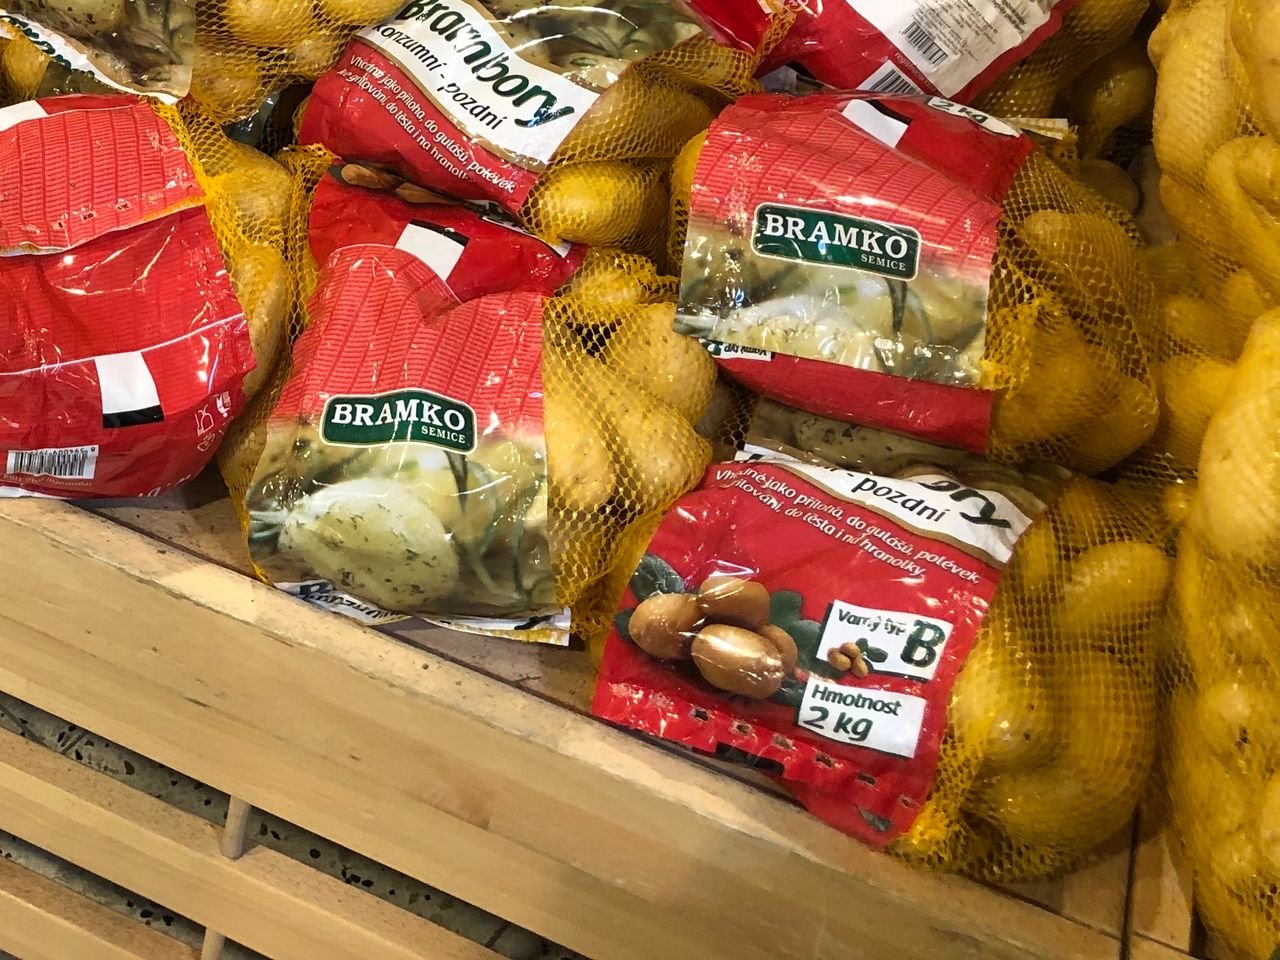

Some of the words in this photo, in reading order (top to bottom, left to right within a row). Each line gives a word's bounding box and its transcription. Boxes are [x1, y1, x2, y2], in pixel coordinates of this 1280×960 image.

[372, 22, 449, 72] konzumní
[436, 81, 509, 131] pozdní
[380, 74, 401, 95] jako
[398, 89, 426, 122] příloha,
[424, 119, 438, 133] do
[434, 129, 469, 165] gulášů,
[385, 101, 398, 115] do
[394, 110, 415, 134] těsta
[416, 135, 430, 151] na
[764, 212, 909, 259] BRAMKO
[860, 253, 907, 272] SEMICE
[331, 398, 466, 432] BRAMKO
[421, 425, 467, 444] SEMICE
[764, 478, 796, 499] jako
[846, 514, 868, 530] do
[784, 506, 804, 520] do
[802, 511, 837, 537] těsta
[850, 476, 951, 523] pozdní
[900, 619, 946, 668] B
[803, 704, 830, 731] 2
[832, 711, 874, 743] kg
[811, 683, 903, 717] Hmotnost
